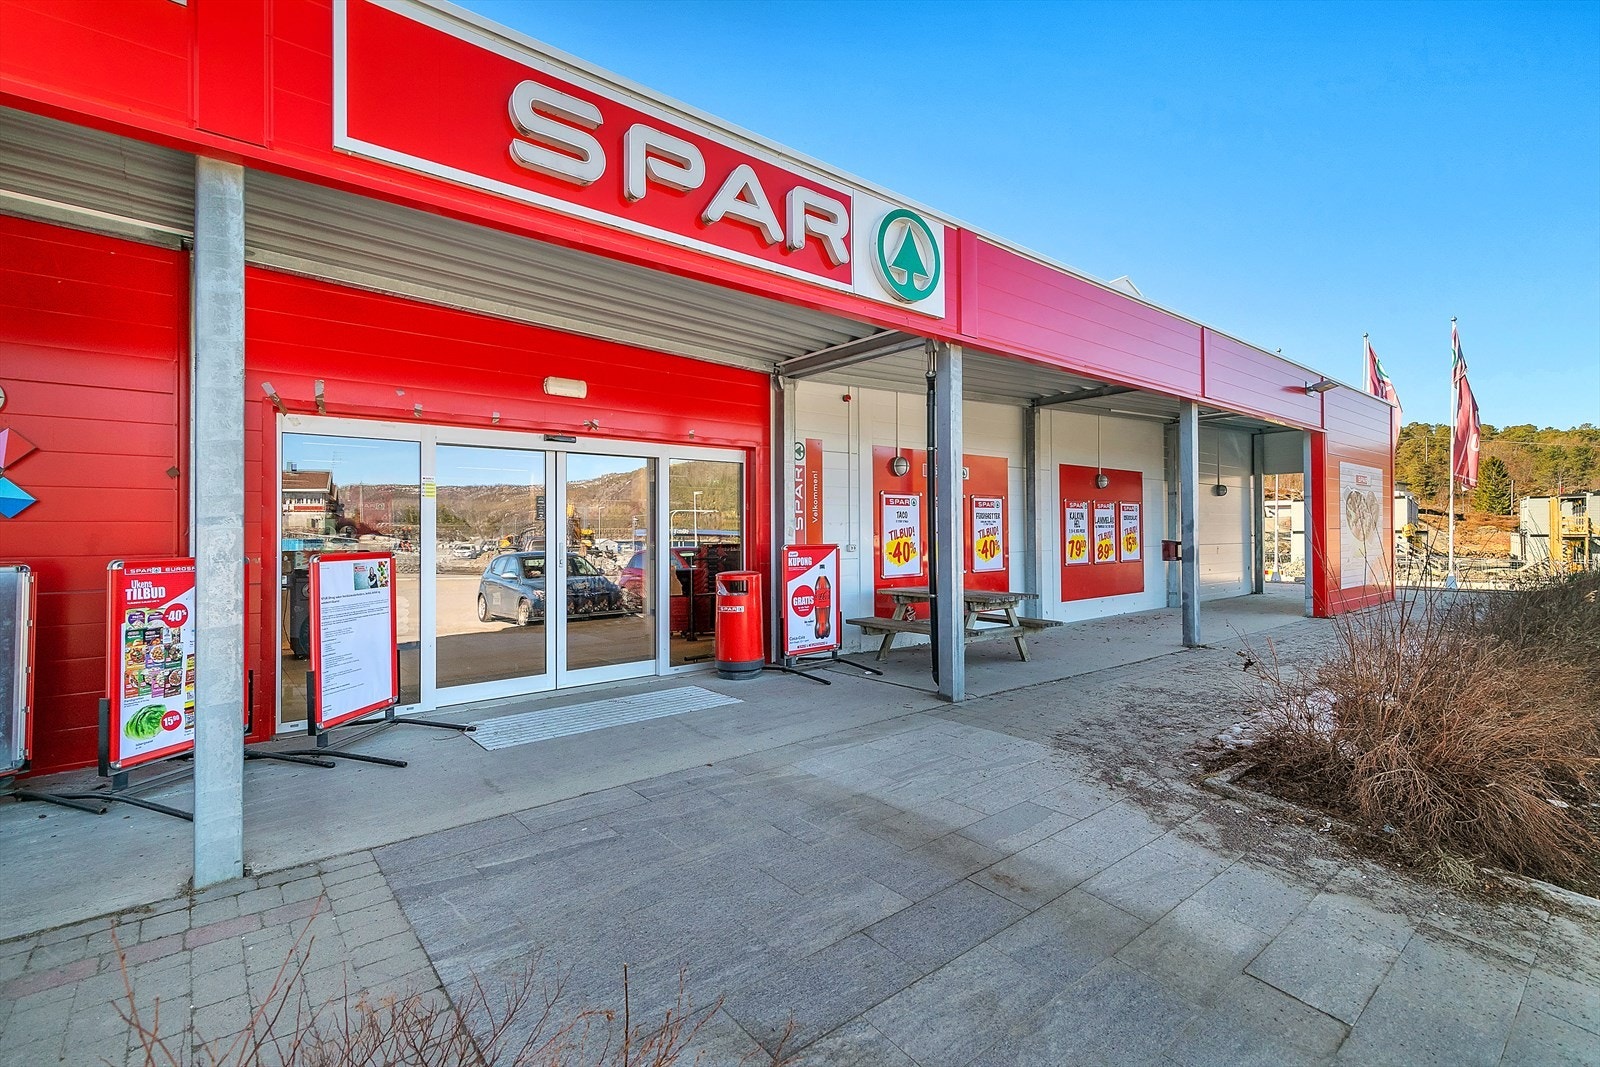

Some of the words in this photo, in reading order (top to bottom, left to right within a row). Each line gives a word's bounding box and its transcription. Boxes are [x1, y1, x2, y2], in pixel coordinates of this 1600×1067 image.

[508, 79, 850, 266] SPAR
[795, 467, 804, 531] SPAR
[896, 511, 908, 519] TACO
[888, 526, 915, 540] TILBUD!
[978, 526, 999, 539] TILBUD!
[889, 541, 916, 563] -40%
[788, 556, 812, 566] KUPONG
[131, 580, 152, 588] Ukens
[125, 587, 166, 600] TILBUD
[793, 595, 814, 606] GRATIS
[165, 609, 187, 622] -40%
